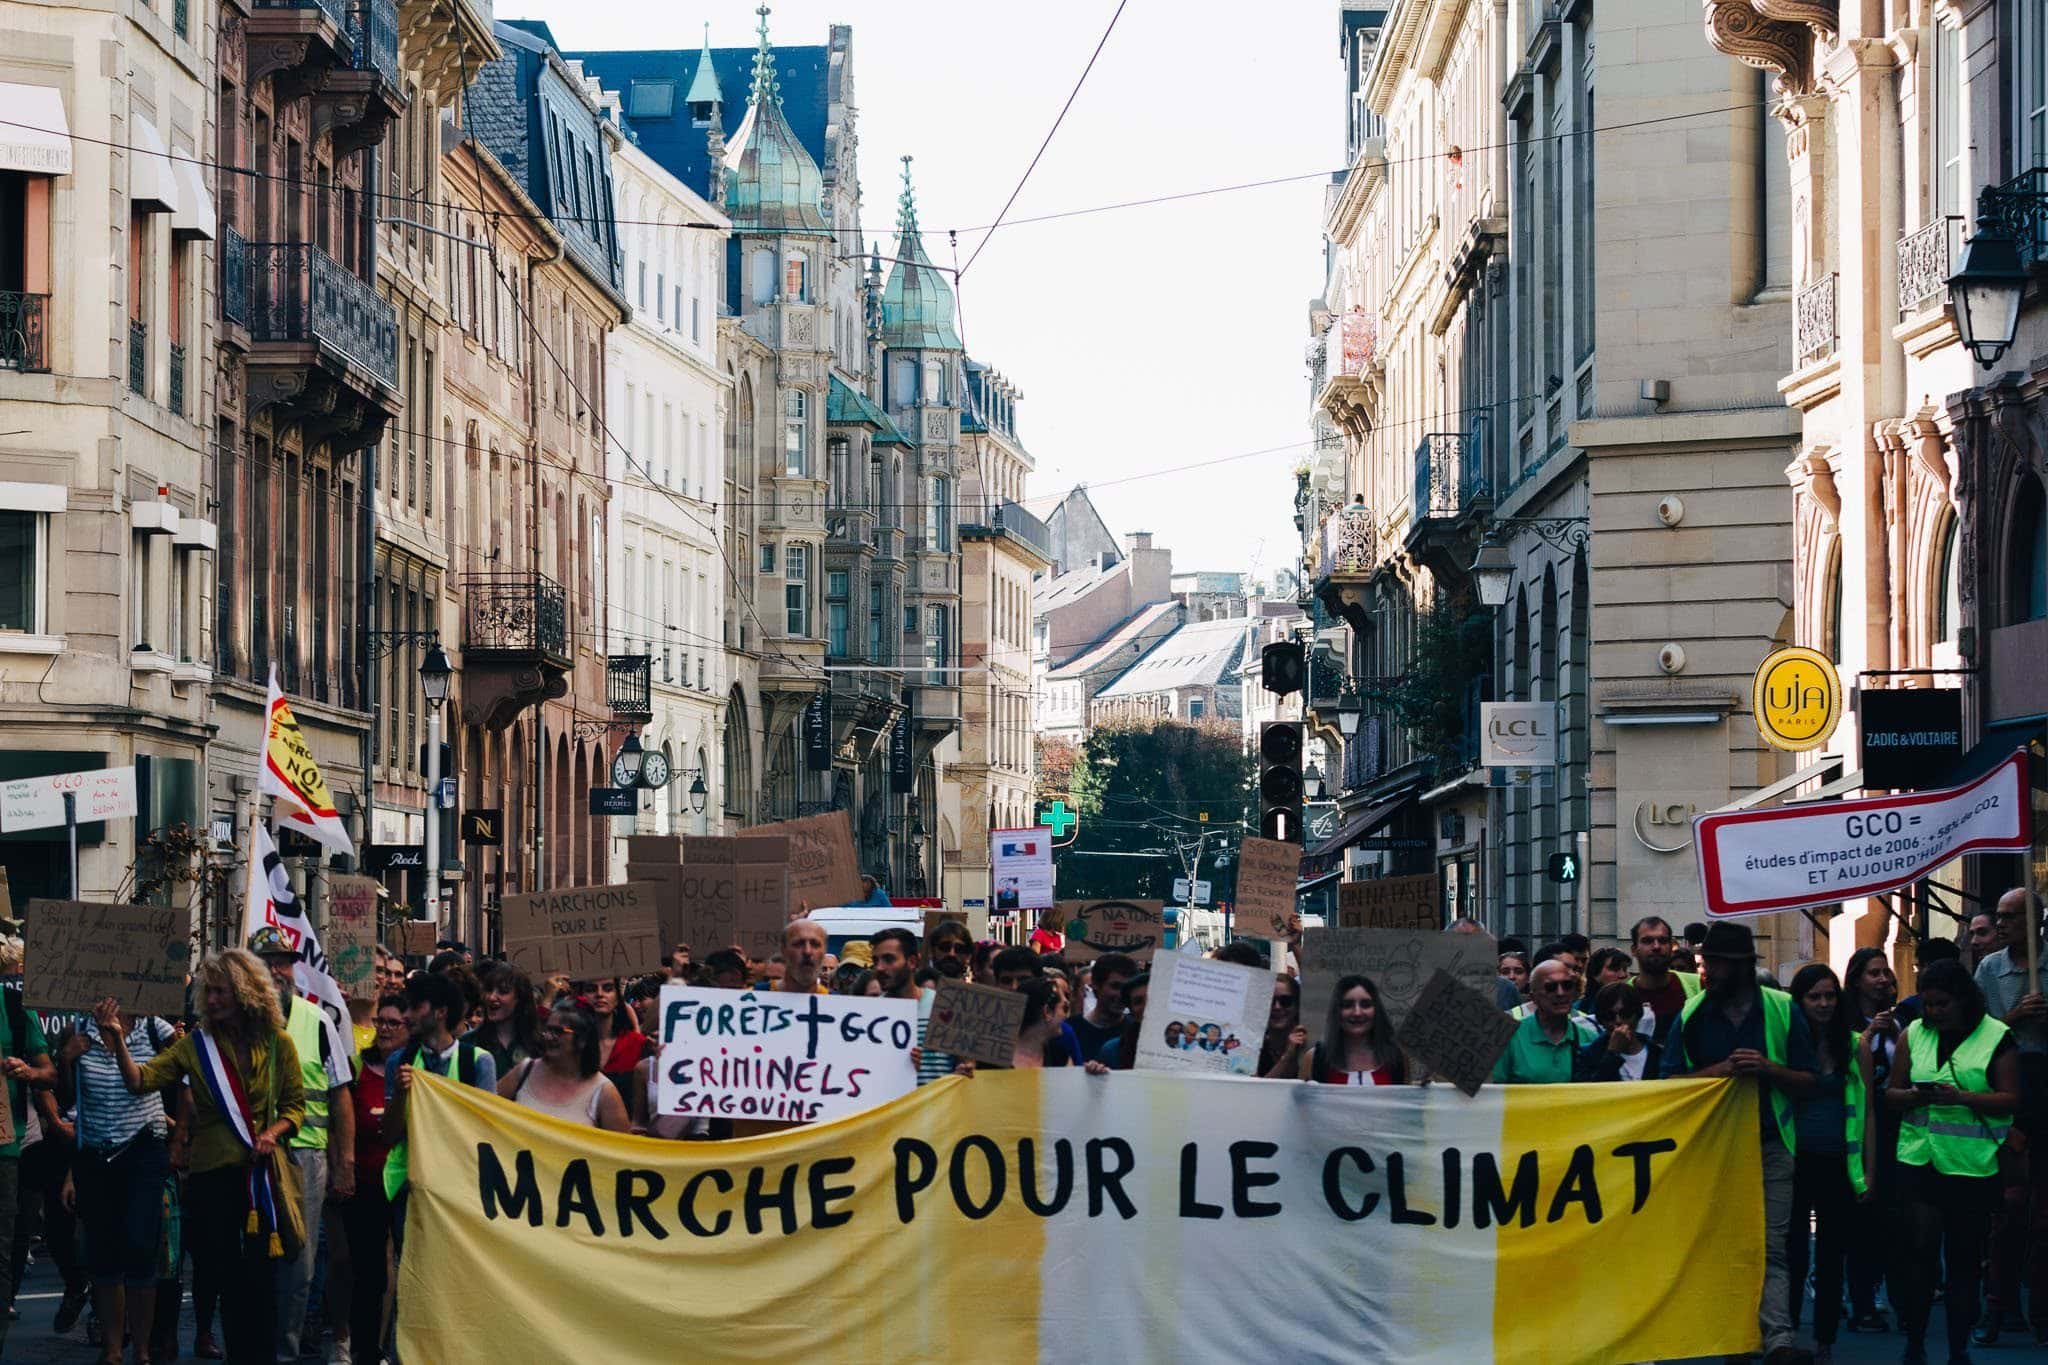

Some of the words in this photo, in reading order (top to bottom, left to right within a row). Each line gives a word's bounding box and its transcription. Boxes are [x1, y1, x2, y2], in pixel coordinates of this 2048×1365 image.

[1495, 720, 1547, 736] LCL
[1777, 718, 1817, 726] PARIS
[1866, 732, 1898, 746] ZADIG
[1909, 731, 1959, 745] VOLTAIRE
[1745, 855, 1797, 870] études
[1799, 847, 1862, 865] d'impact
[1865, 845, 1882, 858] de
[1885, 837, 1920, 854] 2006
[1960, 811, 1973, 824] de
[1974, 795, 2000, 815] CO2
[1846, 811, 1902, 839] GCO
[1910, 816, 1922, 826] =
[1392, 839, 1427, 848] VUITTON
[1808, 869, 1828, 885] ET
[1837, 842, 1943, 881] AUJOURD'HUI
[529, 890, 638, 917] MARCHONS
[1102, 909, 1161, 924] NATURE
[553, 918, 587, 936] POUR
[592, 917, 608, 933] LE
[511, 934, 656, 975] CLIMAT
[665, 992, 794, 1043] FORÊTS
[840, 1012, 911, 1049] GCO
[477, 1142, 856, 1240] MARCHE
[893, 1133, 1138, 1224] POUR
[1179, 1139, 1283, 1219] LE
[1322, 1138, 1677, 1230] CLIMAT
